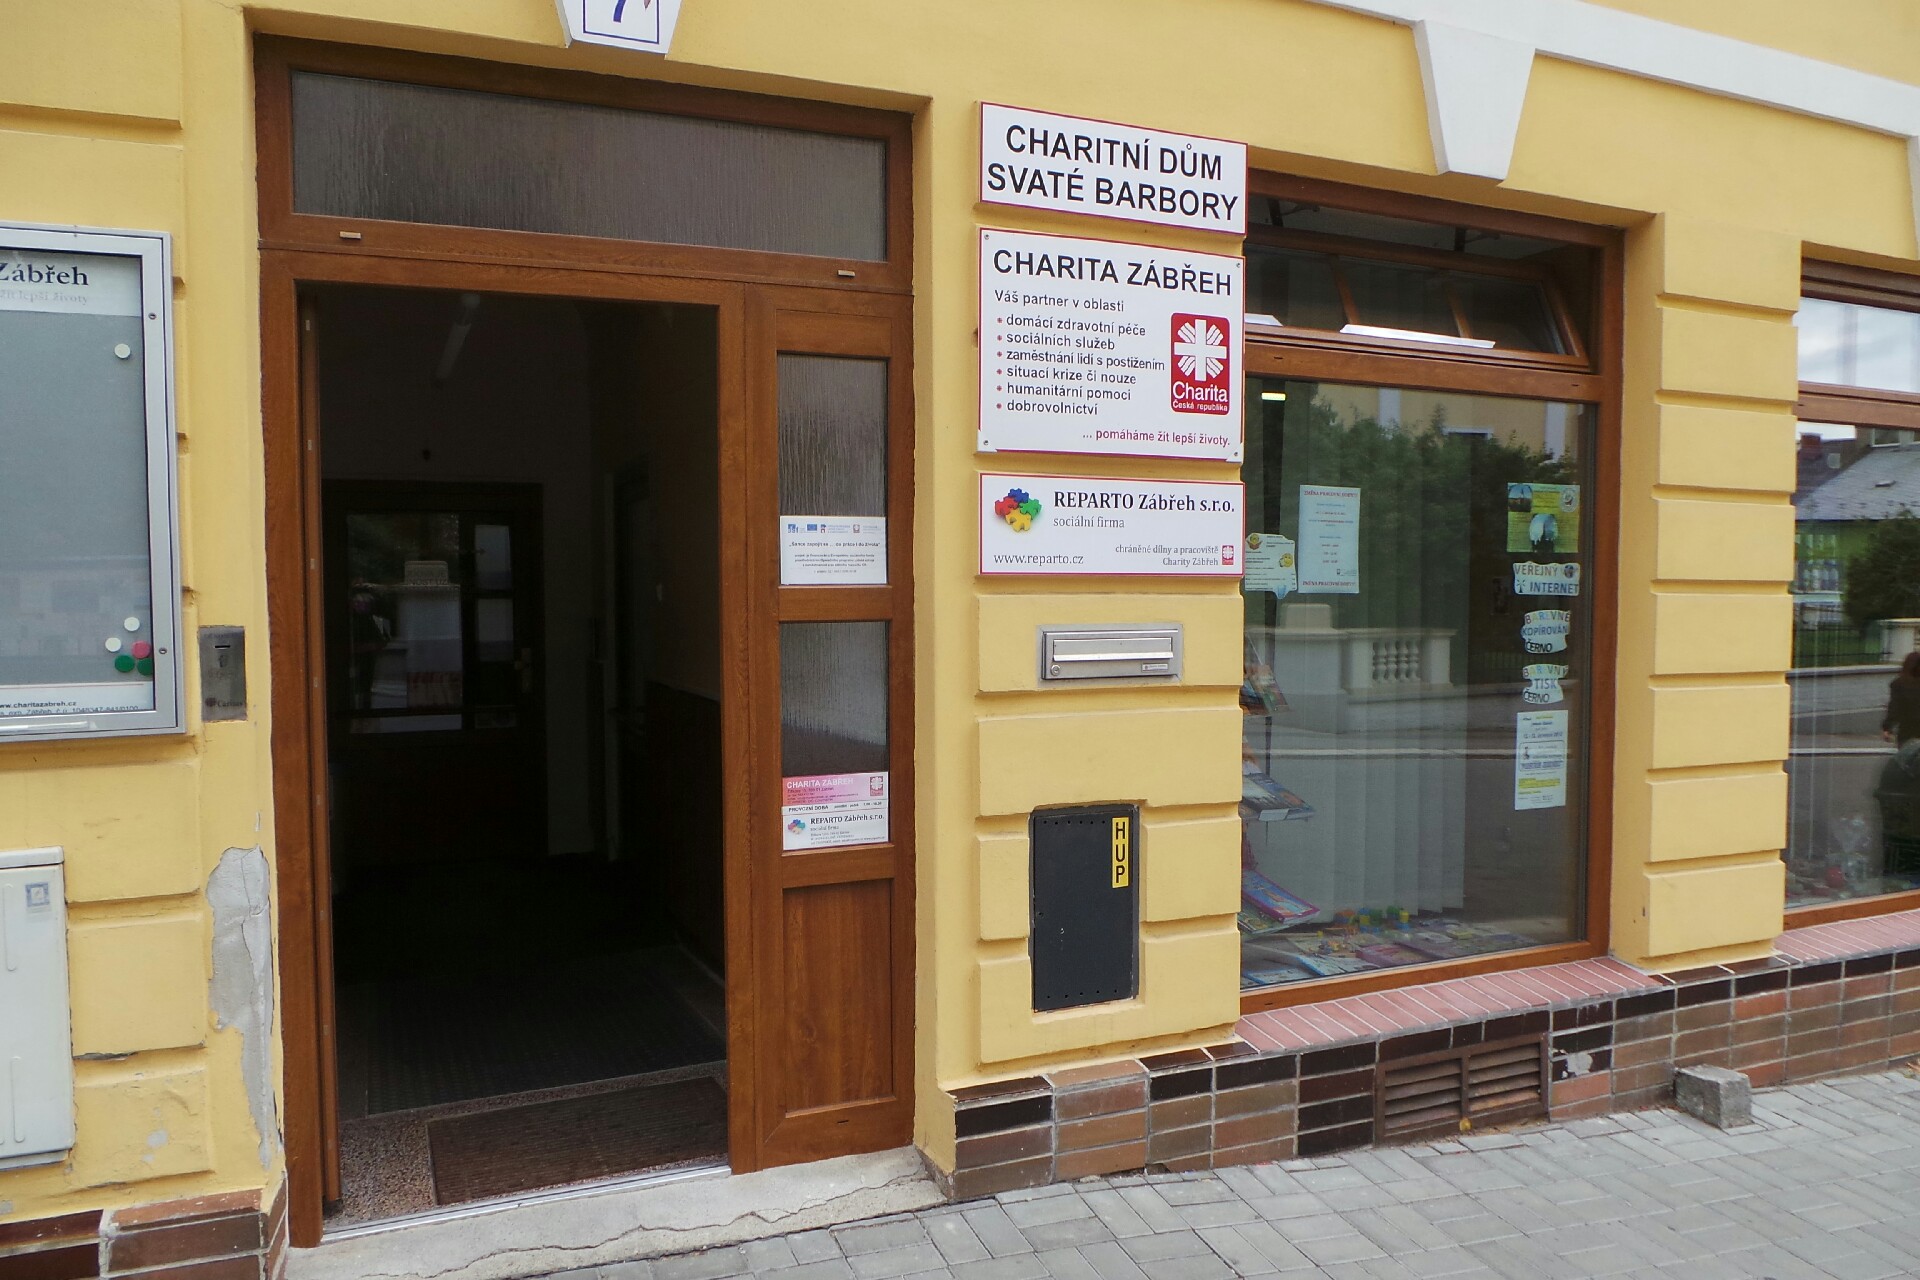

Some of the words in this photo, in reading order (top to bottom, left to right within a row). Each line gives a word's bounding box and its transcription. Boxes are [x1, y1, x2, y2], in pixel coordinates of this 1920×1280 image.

[1005, 124, 1150, 171] CHARITNÍ
[1159, 143, 1222, 181] DŮM
[987, 162, 1085, 202] SVATÉ
[1095, 177, 1239, 221] BARBORY
[993, 249, 1119, 284] CHARITA
[1126, 259, 1232, 296] ZÁBŘEH
[995, 289, 1019, 304] Váš
[1022, 292, 1068, 309] partner
[1073, 299, 1079, 308] v
[1083, 297, 1125, 312] oblasti
[1006, 314, 1053, 329] domácí
[1057, 316, 1115, 334] zdravotní
[1118, 321, 1146, 338] péče
[1006, 332, 1071, 347] sociálních
[1075, 335, 1115, 351] služeb
[1006, 349, 1074, 365] zaměstnání
[1077, 352, 1094, 366] lidí
[1096, 356, 1103, 366] s
[1105, 355, 1165, 372] postižením
[1006, 366, 1049, 380] situací
[1053, 368, 1083, 381] krize
[1086, 369, 1097, 382] či
[1101, 374, 1137, 385] nouze
[1006, 382, 1083, 398] humanitární
[1086, 388, 1132, 401] pomoci
[1172, 380, 1229, 403] Charita
[1006, 400, 1098, 416] dobrovolnictví
[1172, 398, 1195, 410] Česká
[1196, 402, 1229, 413] republika
[1095, 428, 1155, 442] pomáháme
[1157, 430, 1170, 443] žít
[1172, 431, 1197, 446] lepší
[1199, 432, 1231, 447] životy.
[1053, 490, 1134, 510] REPARTO
[1138, 492, 1196, 512] Zábřeh
[1199, 498, 1236, 513] s.r.o.
[1053, 514, 1095, 528] sociální
[1097, 515, 1125, 529] firma
[994, 552, 1084, 566] www.reparto.cz
[1115, 543, 1151, 554] chráněné
[1152, 543, 1172, 556] dílny
[1180, 544, 1219, 557] pracoviště
[1162, 556, 1190, 568] Charity
[1191, 556, 1219, 567] Zábřeh
[1529, 581, 1579, 594] INTERNET
[1525, 638, 1553, 653] ČERNO
[1534, 678, 1557, 690] TISK
[1524, 688, 1550, 703] ČERNO
[786, 780, 821, 789] CHARITA
[810, 816, 843, 825] REPARTO
[844, 813, 868, 822] Zábřeh
[1115, 821, 1126, 884] HUP
